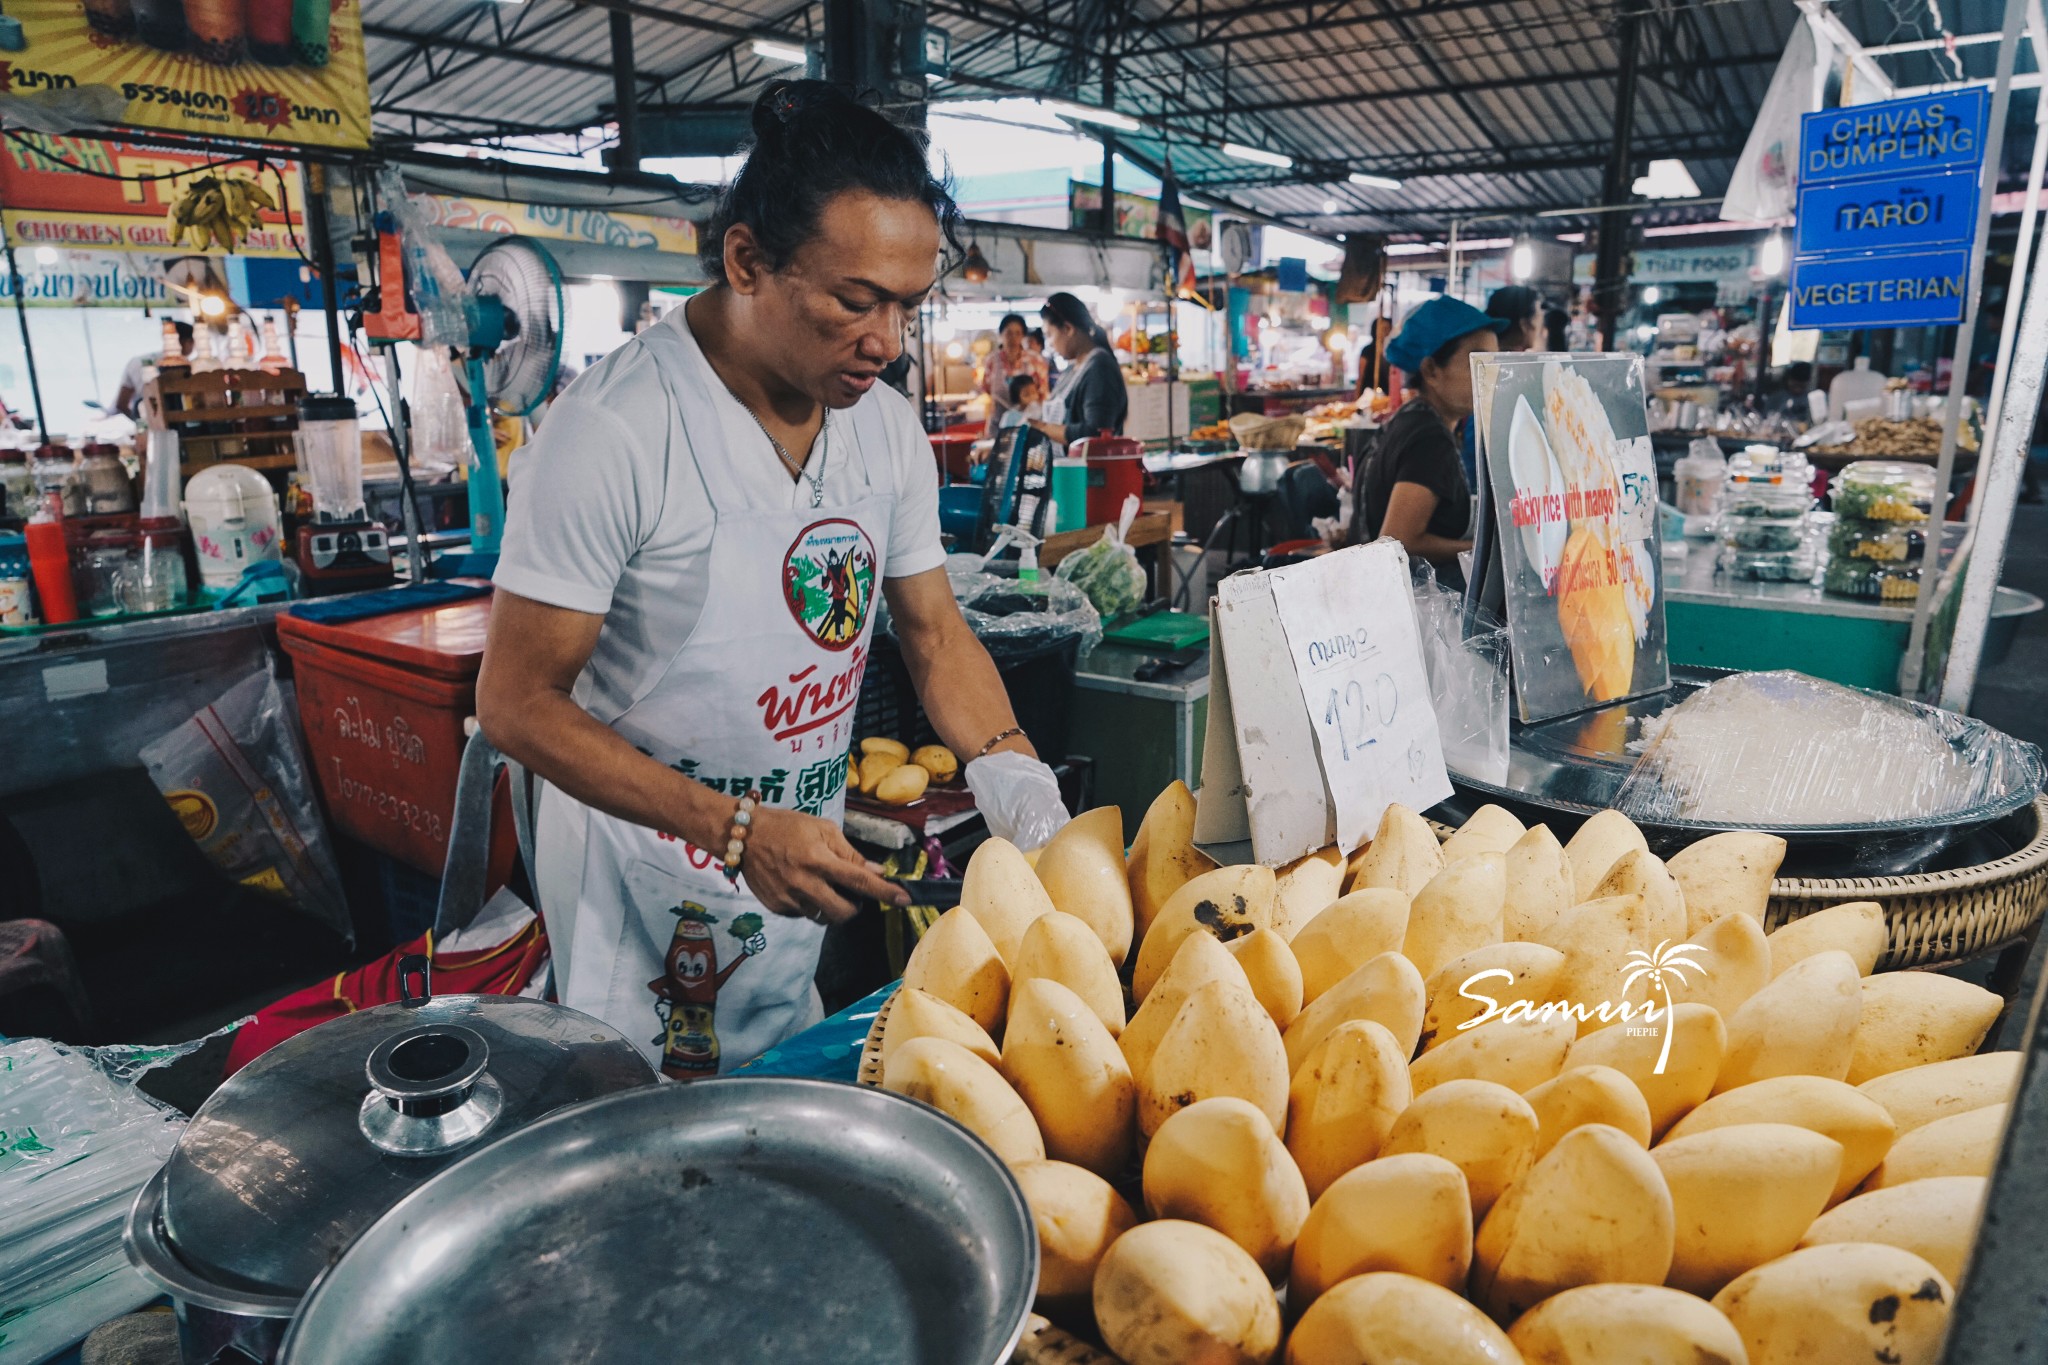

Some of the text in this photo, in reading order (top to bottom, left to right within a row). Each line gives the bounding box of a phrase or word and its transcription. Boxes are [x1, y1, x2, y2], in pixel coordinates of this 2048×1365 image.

[121, 82, 229, 111] ธรรมดา
[292, 104, 341, 126] บาท
[1832, 103, 1945, 142] CHIVAS
[1809, 127, 1973, 173] DUMPLING
[16, 220, 123, 245] CHICKEN
[1841, 201, 1929, 231] TARO
[1795, 275, 1964, 307] VEGETERIAN
[1543, 484, 1561, 523] rice
[1562, 481, 1583, 522] with
[1585, 487, 1615, 526] mango
[1605, 549, 1618, 587] 50
[1324, 672, 1399, 762] 120
